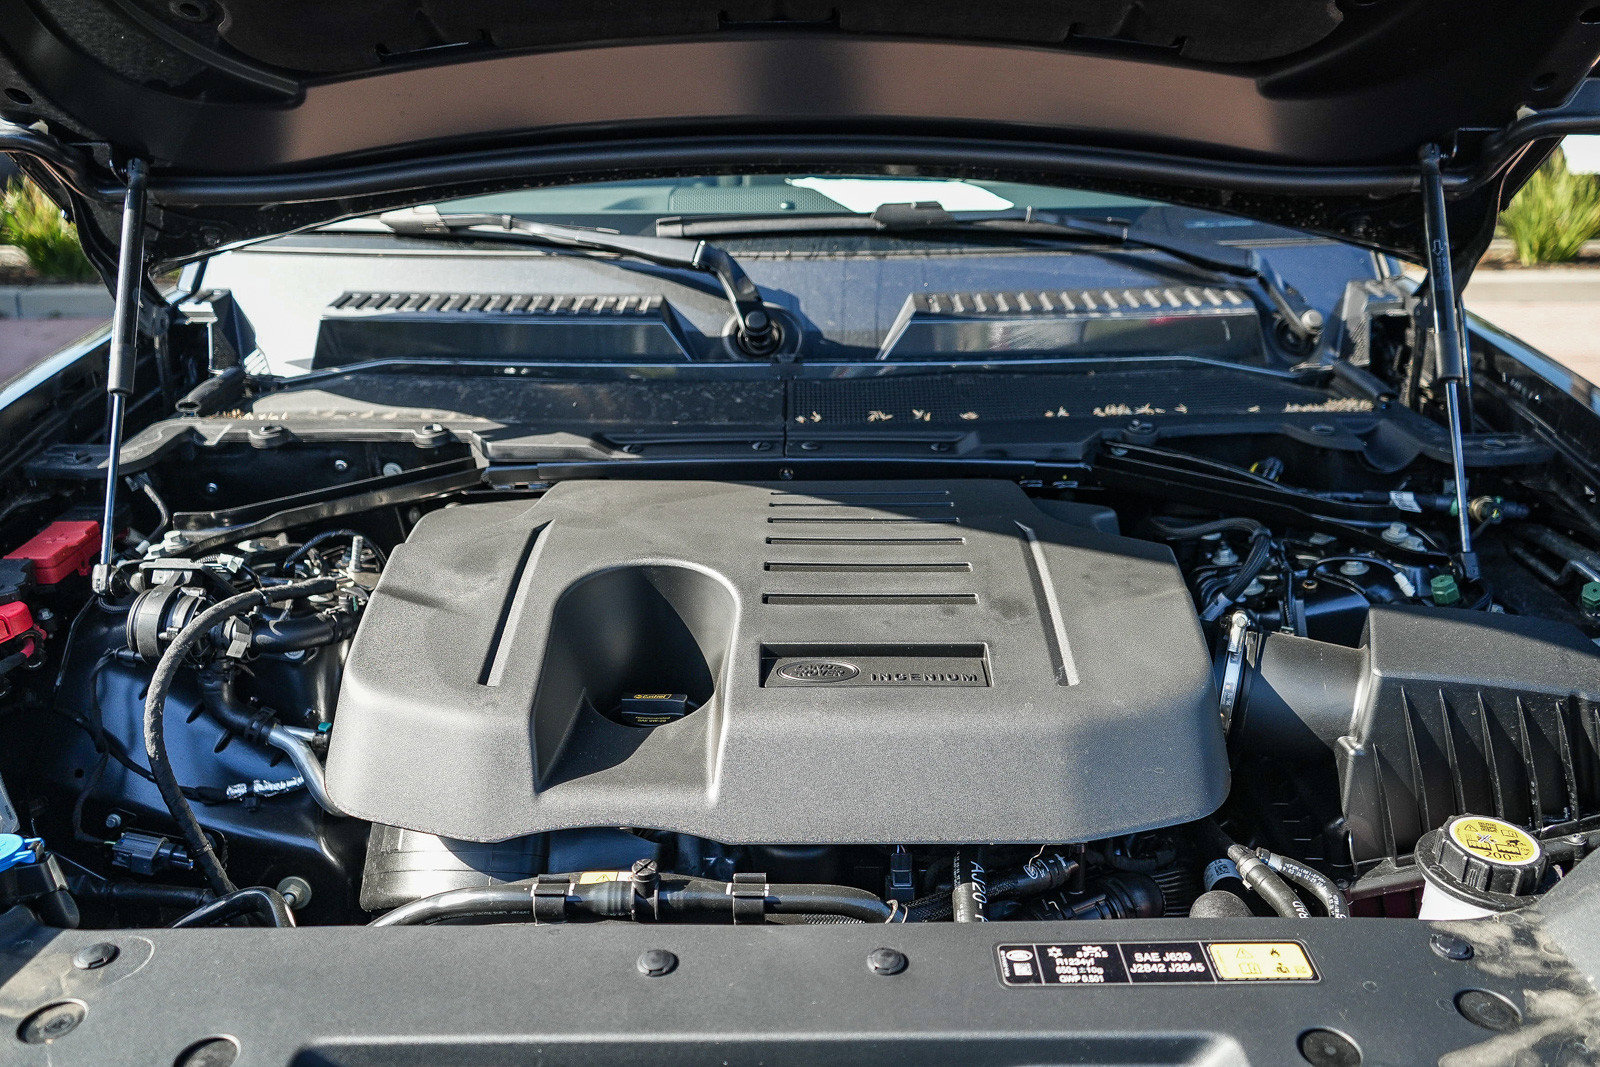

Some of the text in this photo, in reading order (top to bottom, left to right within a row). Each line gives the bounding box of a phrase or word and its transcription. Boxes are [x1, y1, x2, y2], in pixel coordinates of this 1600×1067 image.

[870, 672, 978, 682] INGENIUM
[1486, 851, 1511, 860] 200
[1133, 951, 1192, 962] SAE J639
[1129, 962, 1206, 973] J2842 J2845
